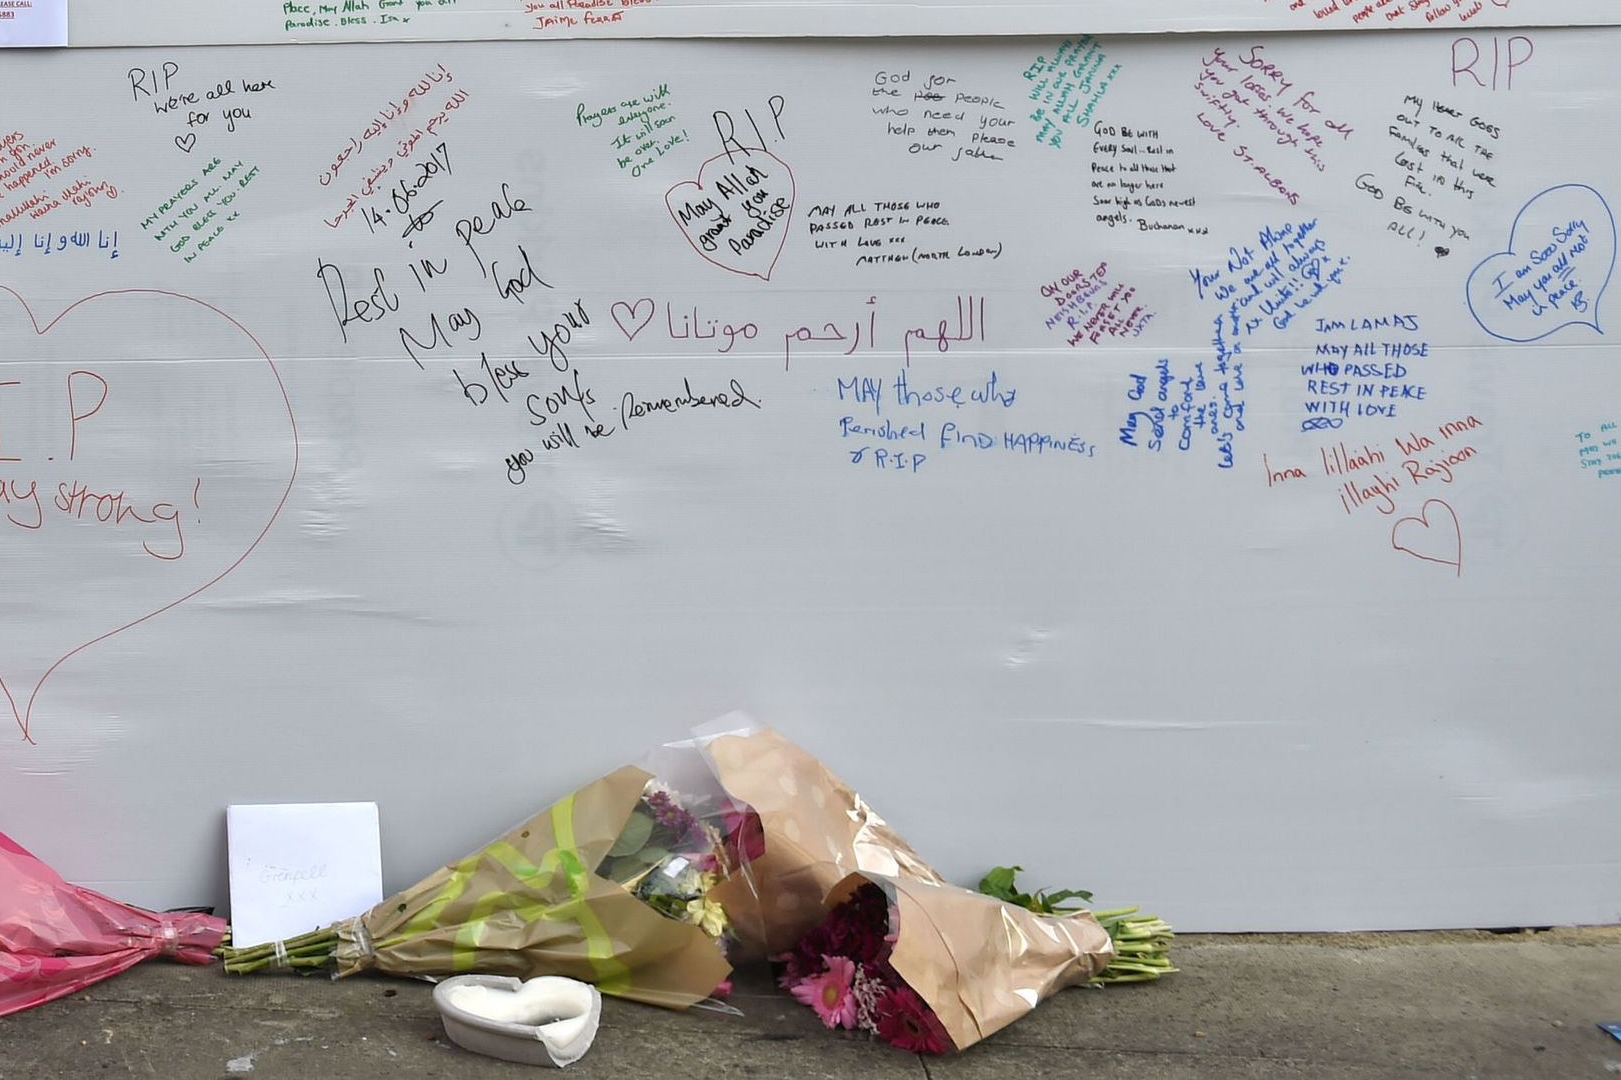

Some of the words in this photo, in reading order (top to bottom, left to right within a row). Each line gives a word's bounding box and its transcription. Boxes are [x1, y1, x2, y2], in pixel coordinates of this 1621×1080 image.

[128, 61, 179, 101] RIP
[1450, 37, 1534, 90] RIP
[206, 80, 235, 100] all
[242, 79, 276, 93] here
[187, 112, 209, 127] for
[222, 107, 252, 132] you
[317, 257, 399, 342] Rest
[412, 255, 448, 293] in
[399, 306, 481, 370] May
[495, 247, 553, 304] God
[904, 294, 986, 369] اللهم
[1382, 342, 1429, 358] THOSE
[453, 340, 530, 408] bless
[535, 297, 592, 373] your
[1345, 363, 1407, 380] PASSED
[1305, 401, 1350, 419] WITH
[1357, 404, 1397, 418] LOVE
[1307, 379, 1351, 395] REST
[1357, 383, 1374, 398] IN
[1380, 383, 1427, 401] PEACE
[505, 445, 535, 486] you
[541, 421, 581, 450] will
